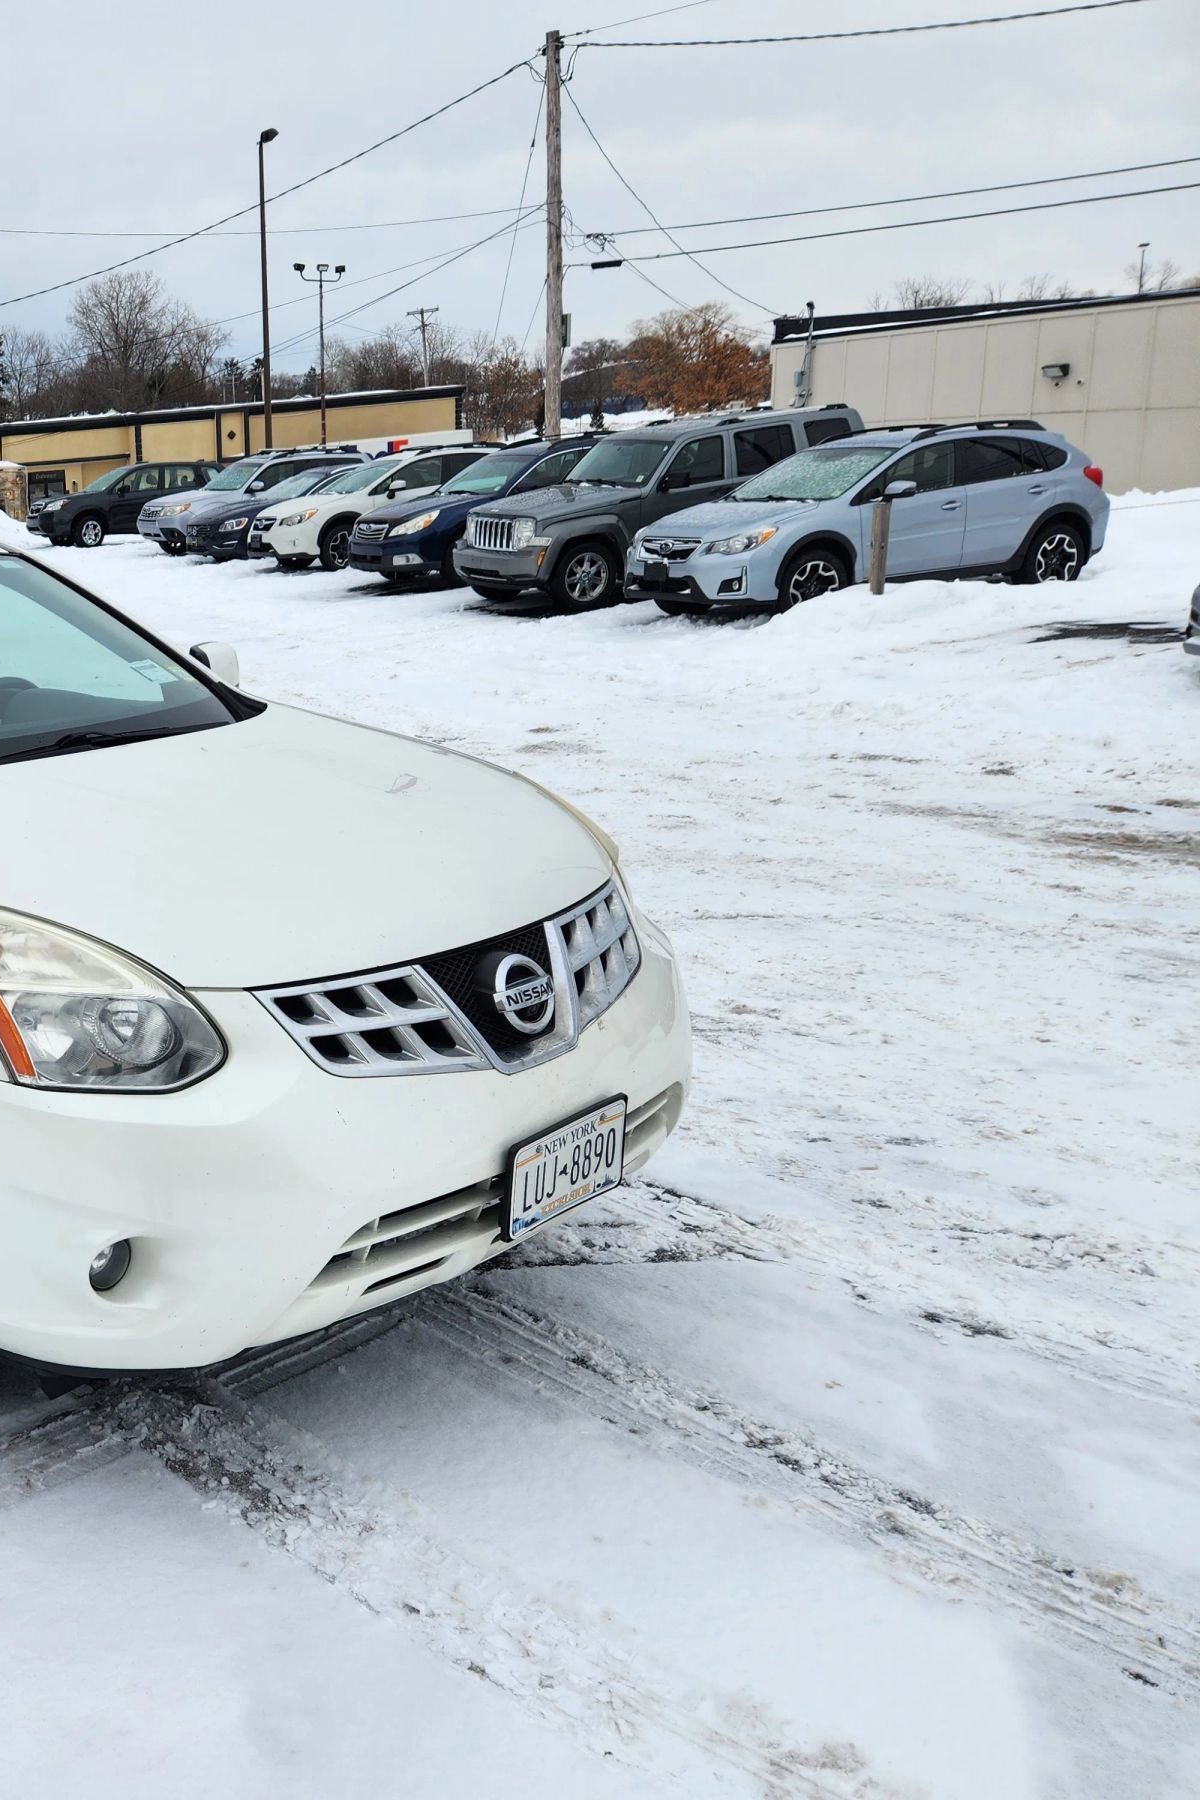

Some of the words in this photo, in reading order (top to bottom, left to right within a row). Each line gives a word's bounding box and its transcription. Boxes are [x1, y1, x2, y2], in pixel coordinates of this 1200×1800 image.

[506, 981, 554, 1006] NISSAN
[543, 1134, 569, 1158] NEW
[570, 1118, 598, 1143] YORK
